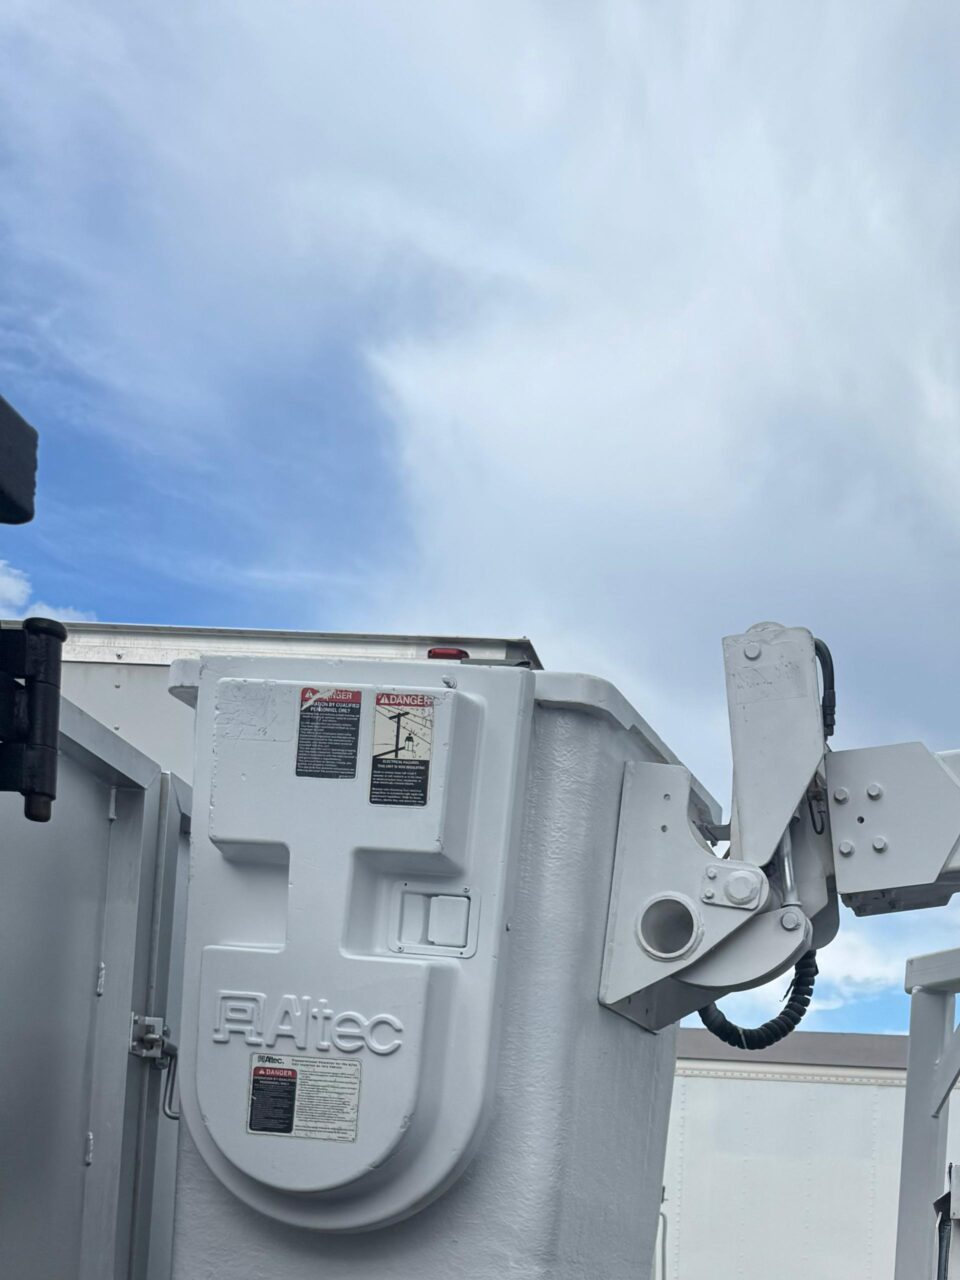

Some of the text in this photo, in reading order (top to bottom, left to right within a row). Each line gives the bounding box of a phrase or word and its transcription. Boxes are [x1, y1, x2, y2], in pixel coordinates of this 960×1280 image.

[316, 690, 353, 701] NGER
[265, 993, 404, 1056] Altec
[266, 1069, 292, 1077] DANGER
